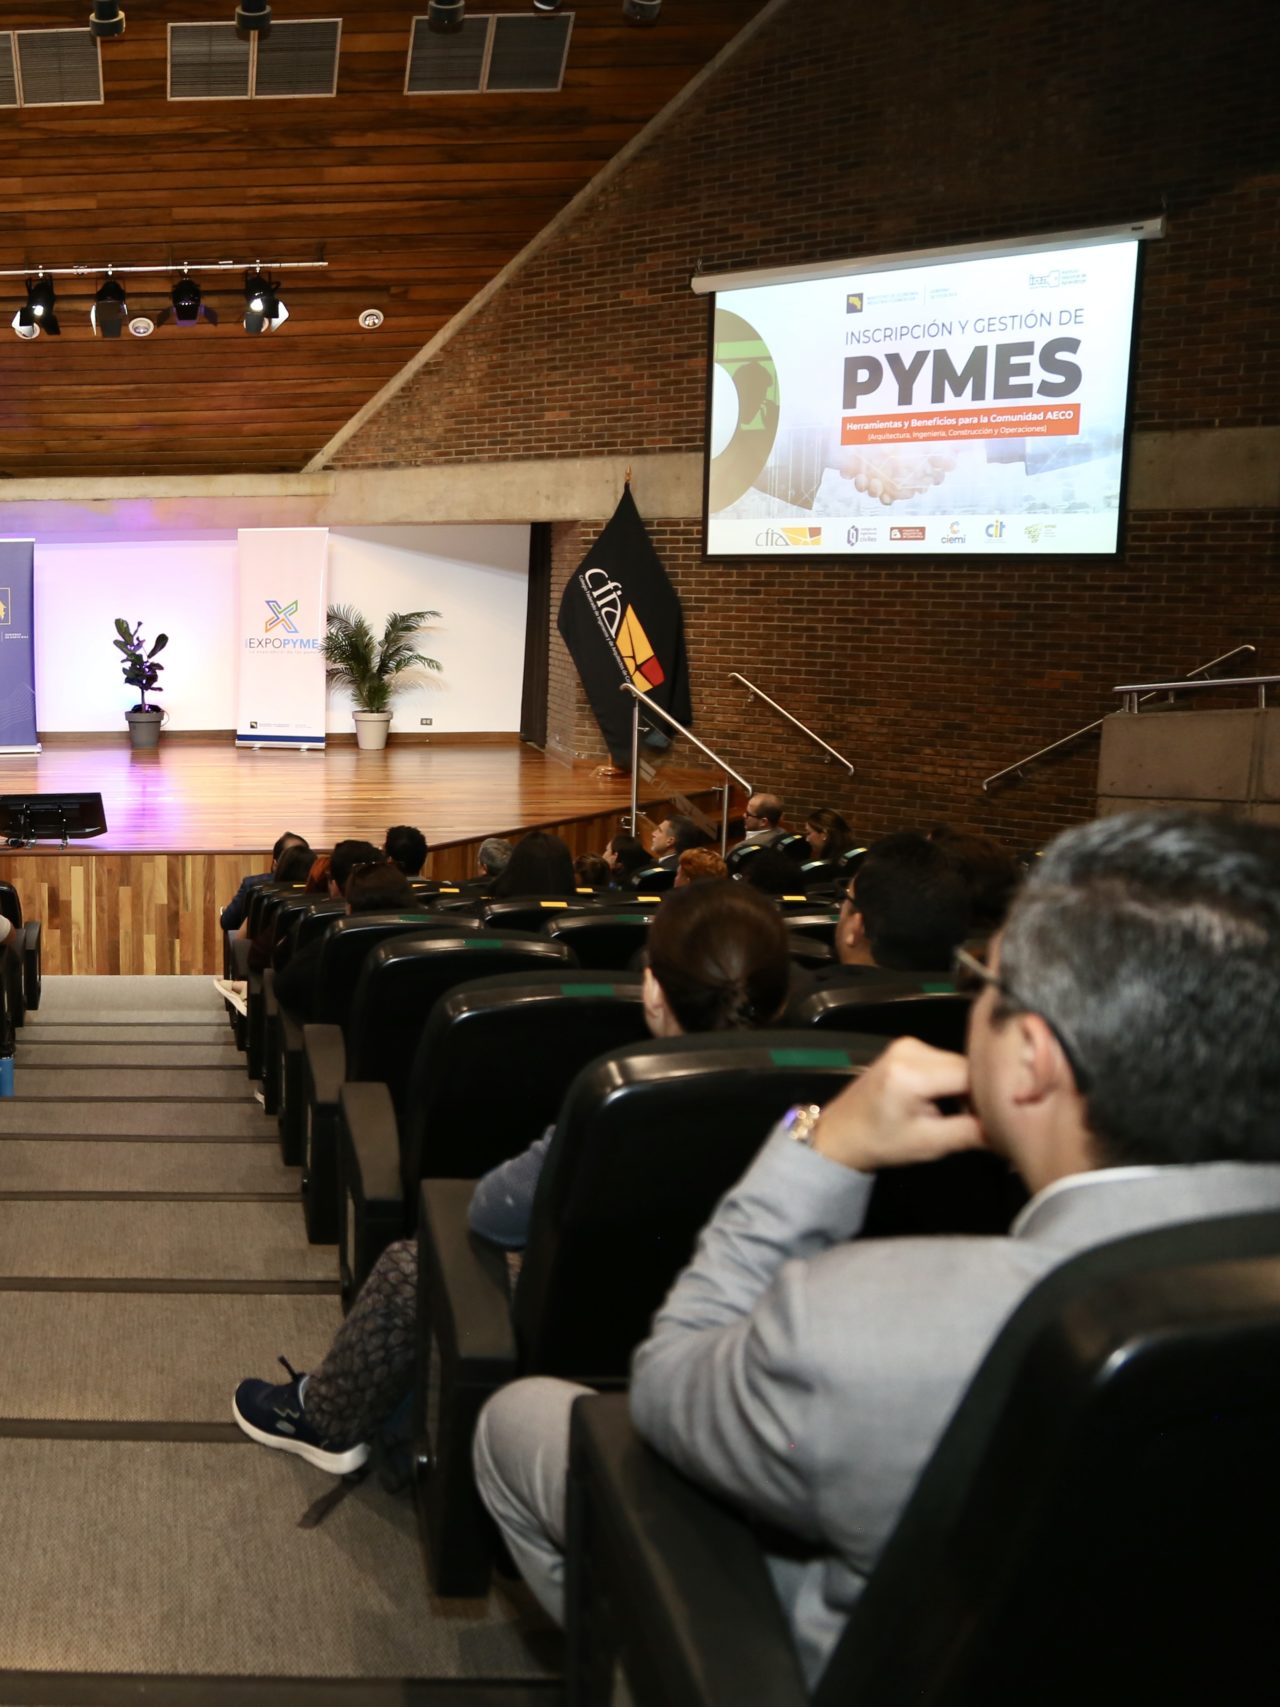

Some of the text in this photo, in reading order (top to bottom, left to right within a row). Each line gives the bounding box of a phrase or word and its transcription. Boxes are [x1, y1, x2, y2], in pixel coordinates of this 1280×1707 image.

[845, 308, 1085, 345] INSCRIPCIÓN Y GESTIÓN DE
[842, 337, 1082, 409] PYMES
[846, 410, 1074, 431] Herramientas y Beneficios para la Comunidad AECO
[941, 533, 966, 544] ciemi
[984, 519, 1005, 538] cit
[585, 568, 622, 639] cfia
